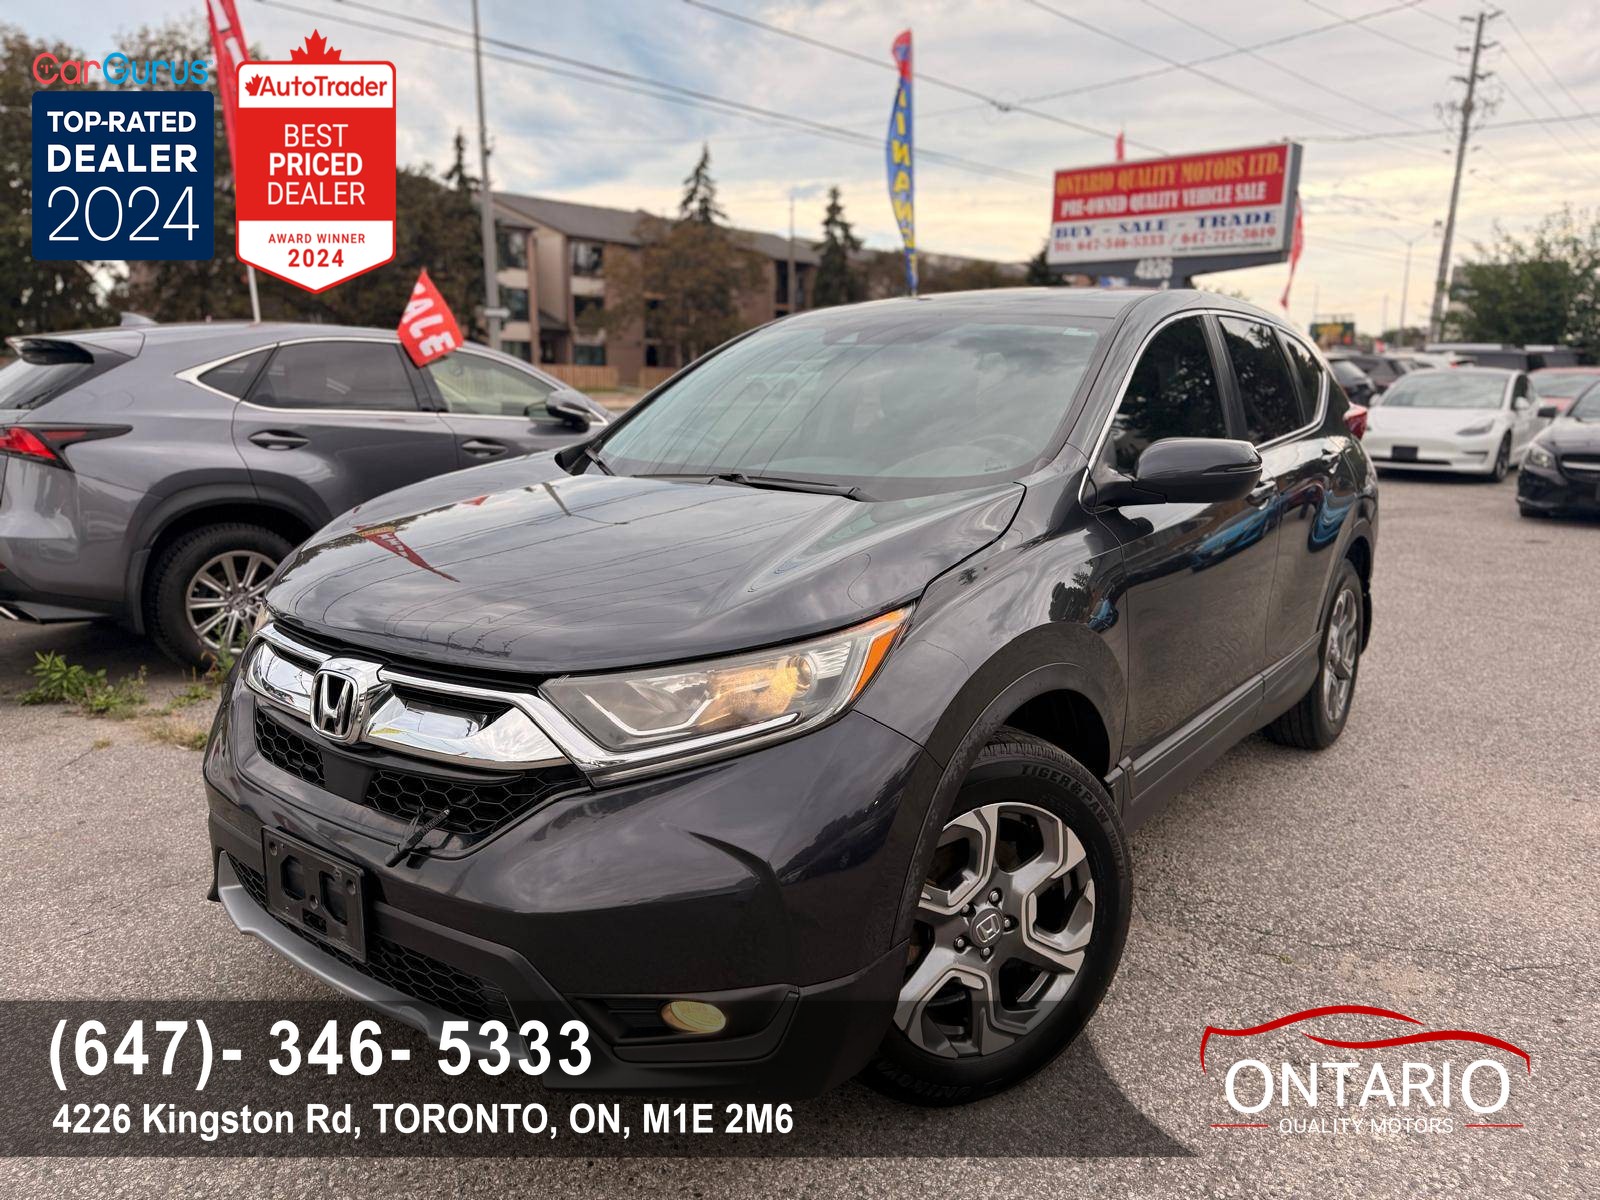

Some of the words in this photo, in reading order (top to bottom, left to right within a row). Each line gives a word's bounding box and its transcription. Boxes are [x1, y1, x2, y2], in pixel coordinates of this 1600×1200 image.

[1056, 171, 1115, 196] ONTARIO
[1117, 164, 1177, 192] QUALITY
[1181, 157, 1244, 186] MOTORS
[1129, 188, 1181, 213] QUALITY
[1182, 184, 1232, 208] VEHICLE
[1234, 181, 1267, 202] SALE
[1055, 224, 1096, 239] BUY
[1118, 219, 1170, 235] SALE
[1196, 211, 1277, 229] TRADE
[1022, 764, 1072, 787] TIGER
